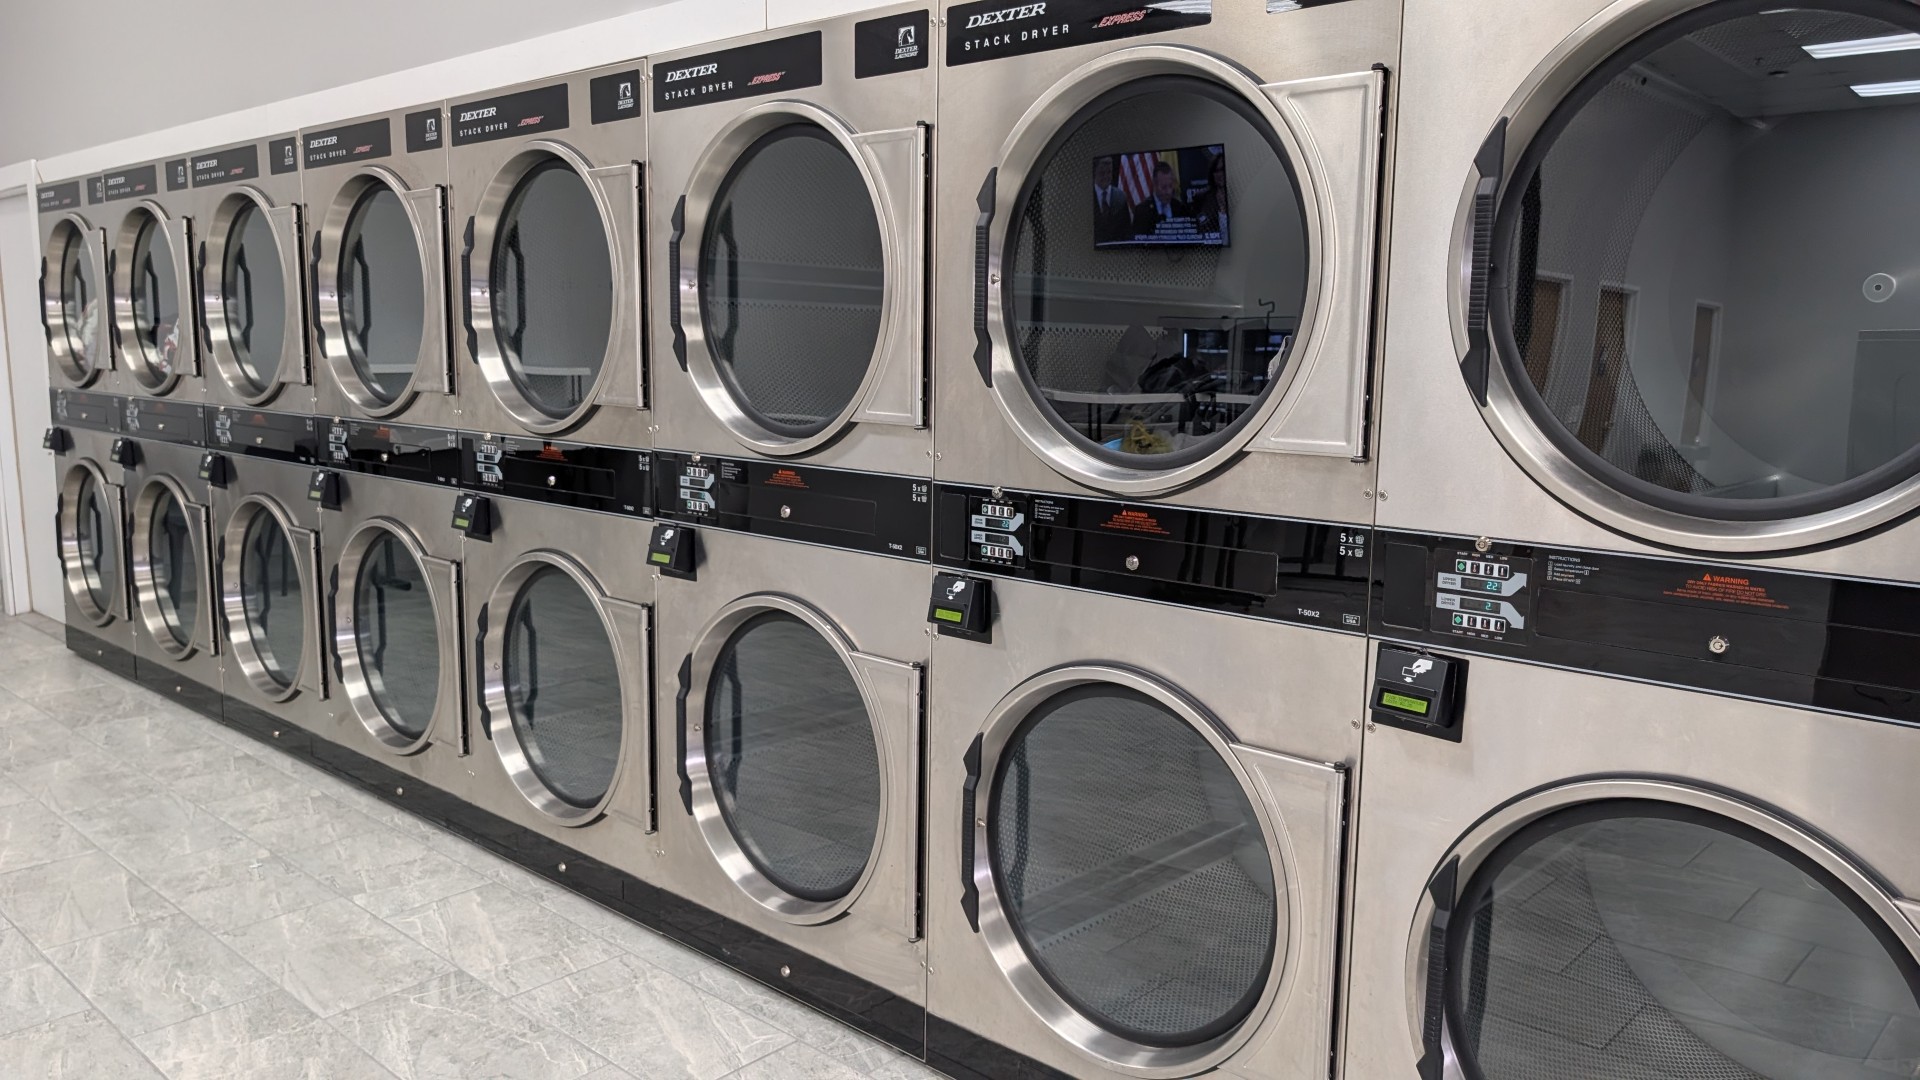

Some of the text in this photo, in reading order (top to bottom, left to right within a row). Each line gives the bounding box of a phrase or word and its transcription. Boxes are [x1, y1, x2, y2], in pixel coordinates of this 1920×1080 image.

[965, 2, 1047, 29] DEXTER
[1098, 9, 1147, 28] EXPRESS
[965, 24, 1070, 51] STACK DRYER
[895, 45, 918, 55] DEXTER
[665, 63, 718, 83] DEXTER
[751, 72, 782, 85] EXPRESS
[665, 81, 734, 101] STACK DRYER
[459, 106, 497, 123] DEXTER
[459, 122, 508, 137] STACK DRYER
[309, 135, 338, 149] DEXTER
[196, 159, 218, 170] DEXTER
[912, 483, 917, 492] 5
[912, 493, 917, 502] 5
[1340, 532, 1347, 543] 5
[1339, 546, 1346, 556] 5
[1548, 554, 1581, 563] INSTRUCTIONS
[1712, 575, 1750, 586] WARNING
[1485, 602, 1492, 611] 2
[1297, 608, 1320, 618] T-50X2
